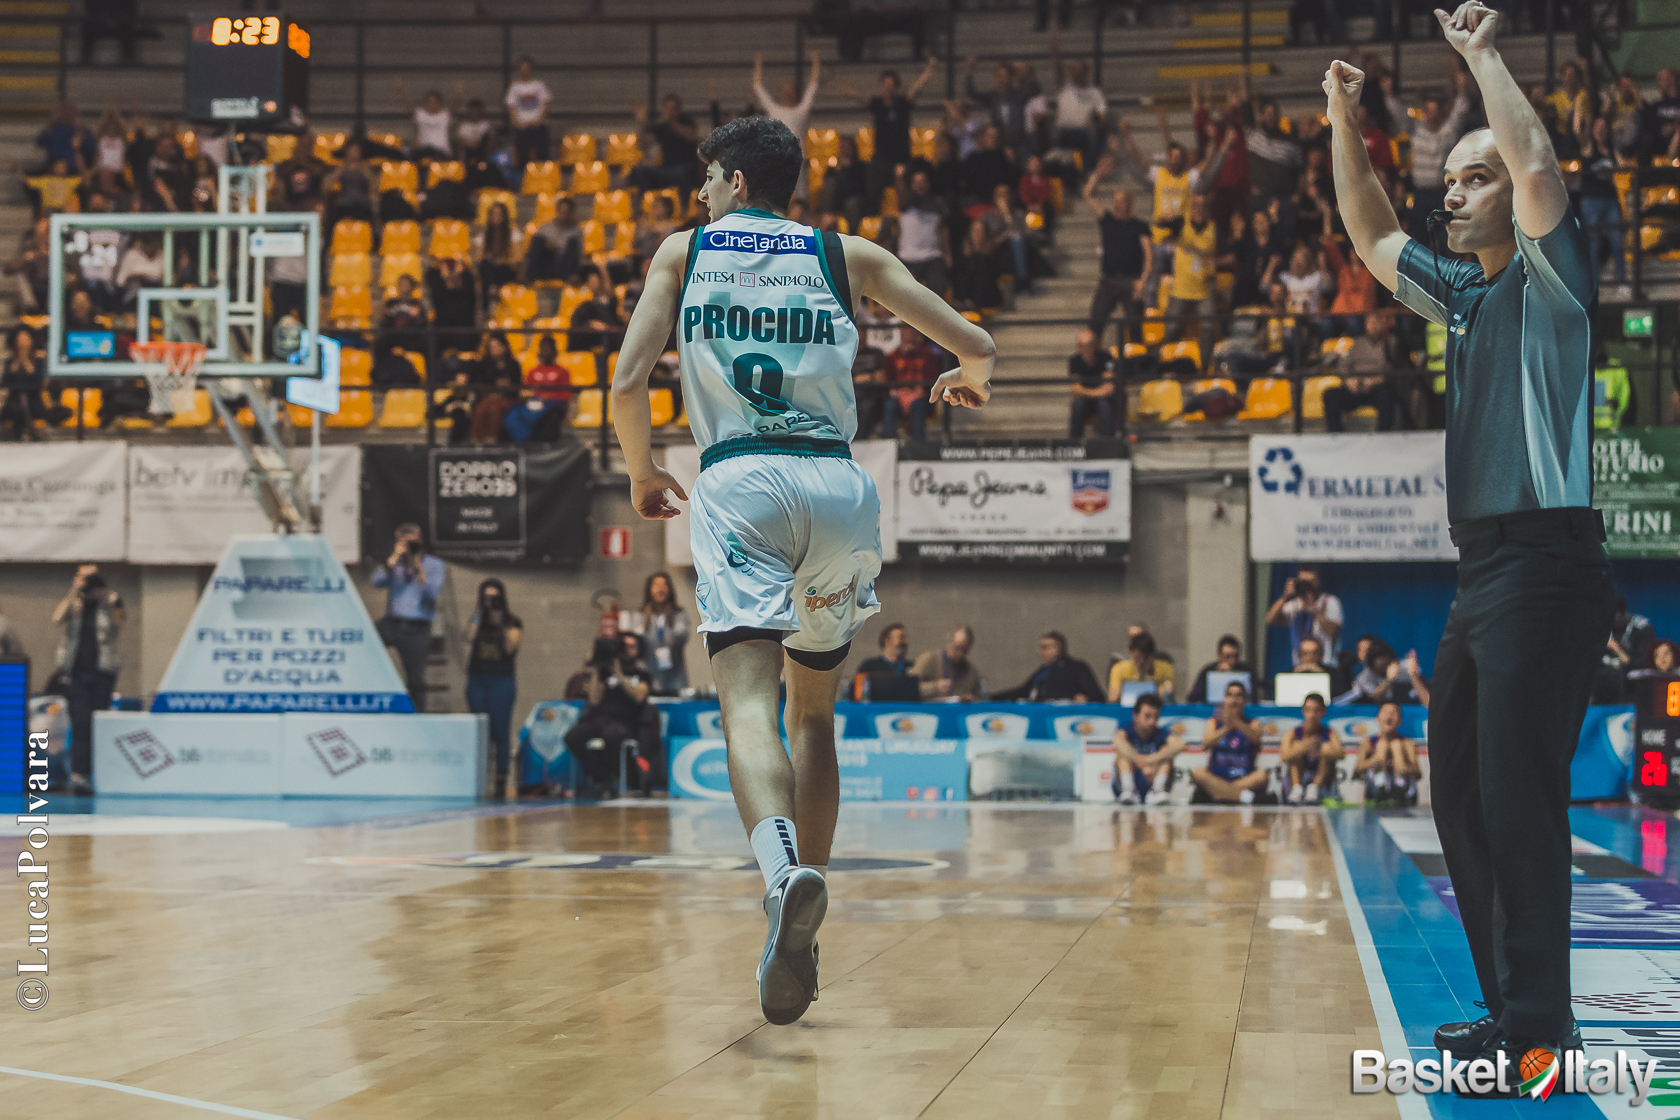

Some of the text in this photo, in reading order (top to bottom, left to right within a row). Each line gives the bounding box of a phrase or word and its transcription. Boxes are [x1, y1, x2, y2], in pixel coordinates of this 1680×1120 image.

[691, 271, 825, 289] INTESA SANPAOLO
[683, 303, 837, 346] PROCIDA
[214, 575, 346, 595] PAPARELLI
[197, 628, 363, 645] FILTRI E TUBI
[212, 649, 346, 664] PER POZZI
[223, 668, 342, 686] D'ACQUA
